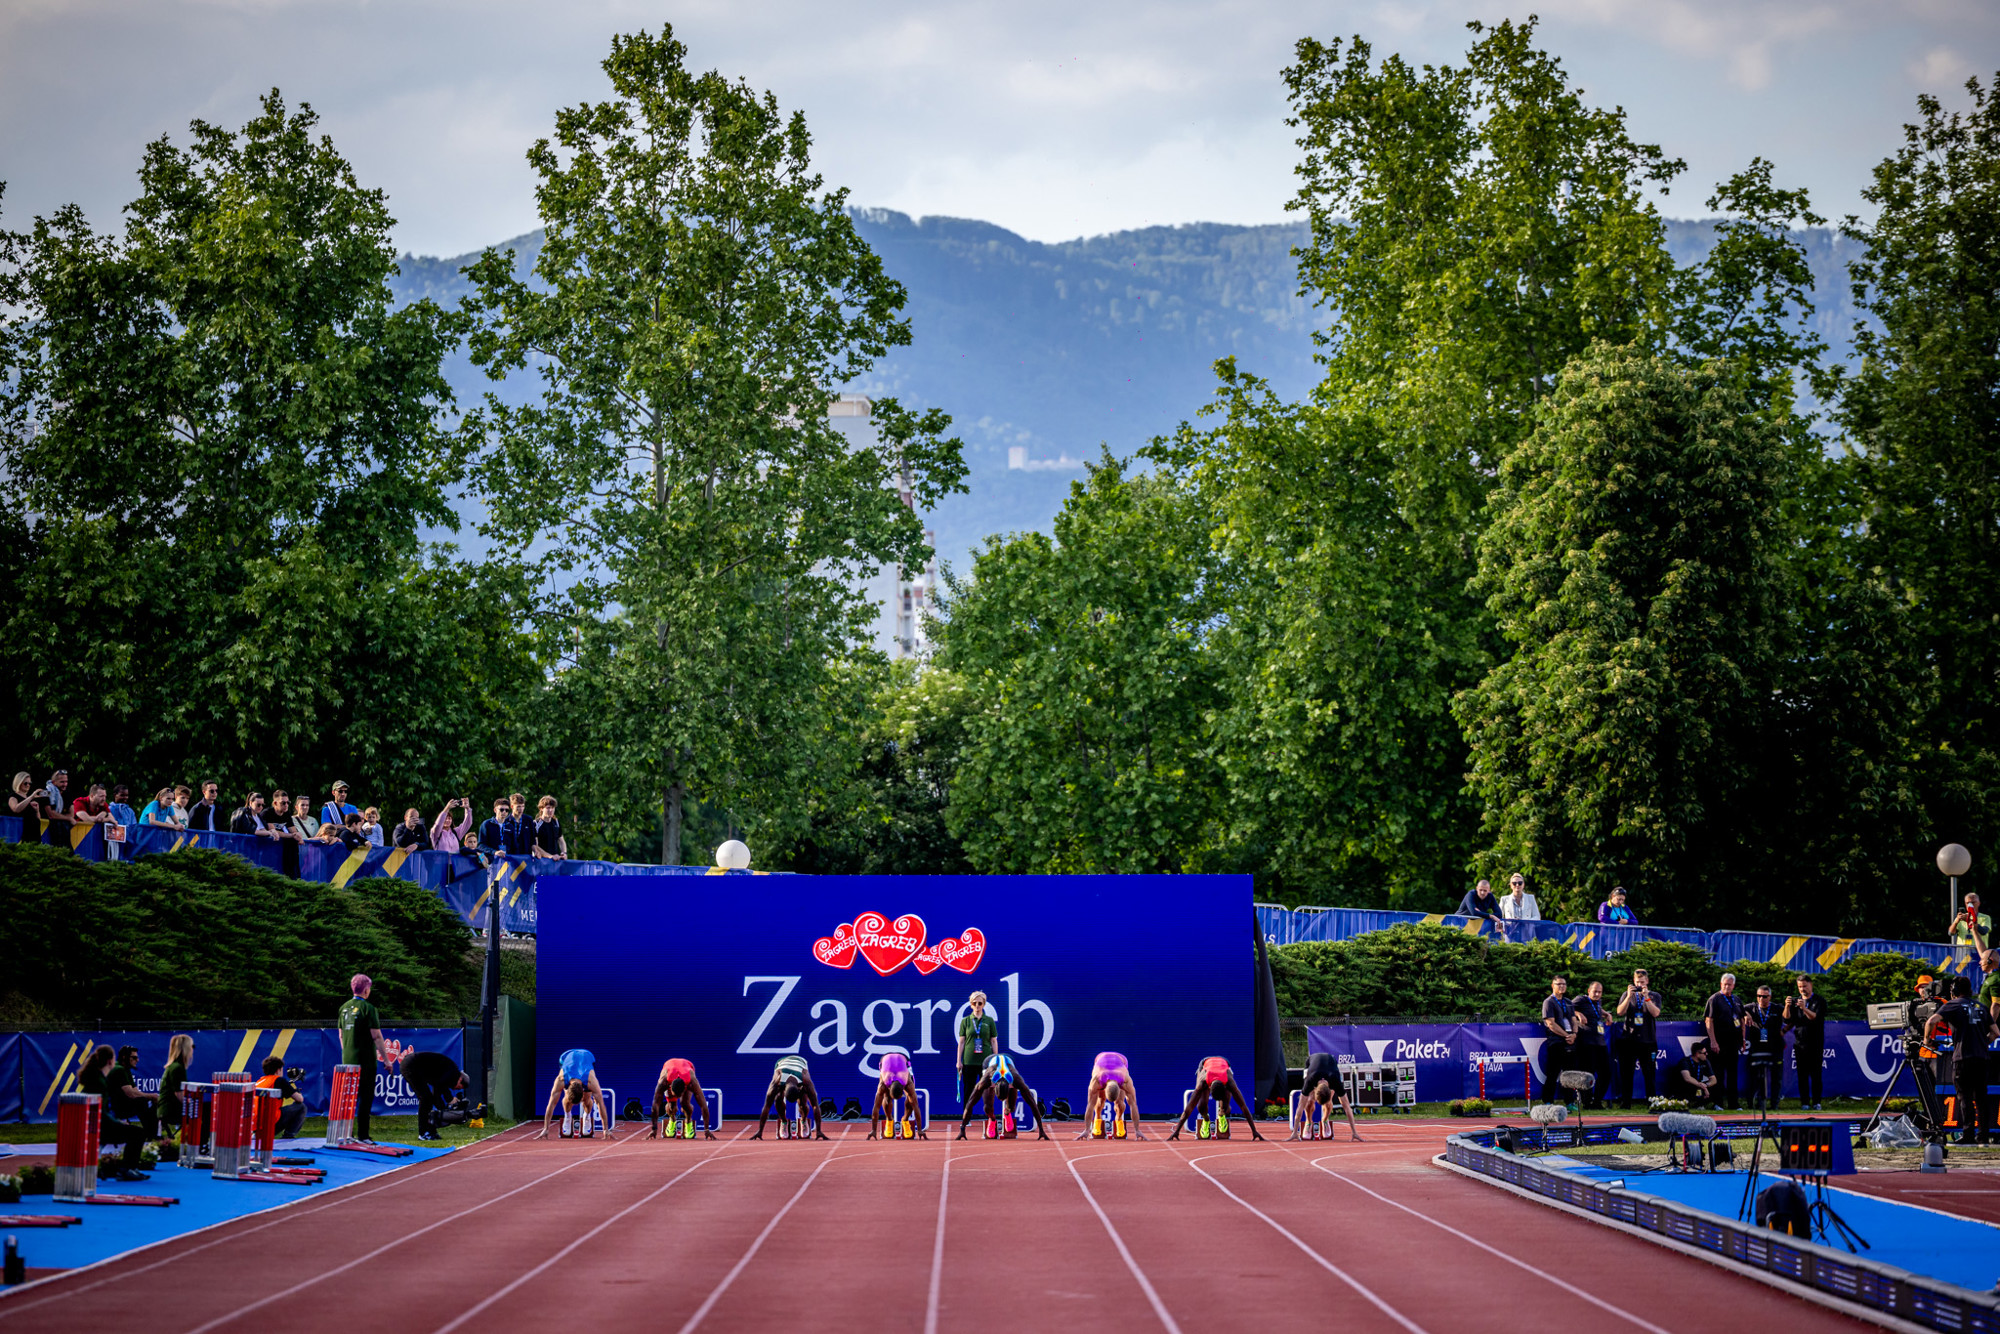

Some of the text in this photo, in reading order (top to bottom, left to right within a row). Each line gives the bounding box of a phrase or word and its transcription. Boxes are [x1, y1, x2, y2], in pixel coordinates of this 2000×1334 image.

[821, 936, 856, 963] ZAGREB
[860, 934, 918, 953] ZAGREB
[945, 941, 982, 963] ZAGREB
[1469, 1062, 1504, 1072] DOTAVA
[1014, 1101, 1025, 1121] 4
[1101, 1101, 1112, 1121] 3
